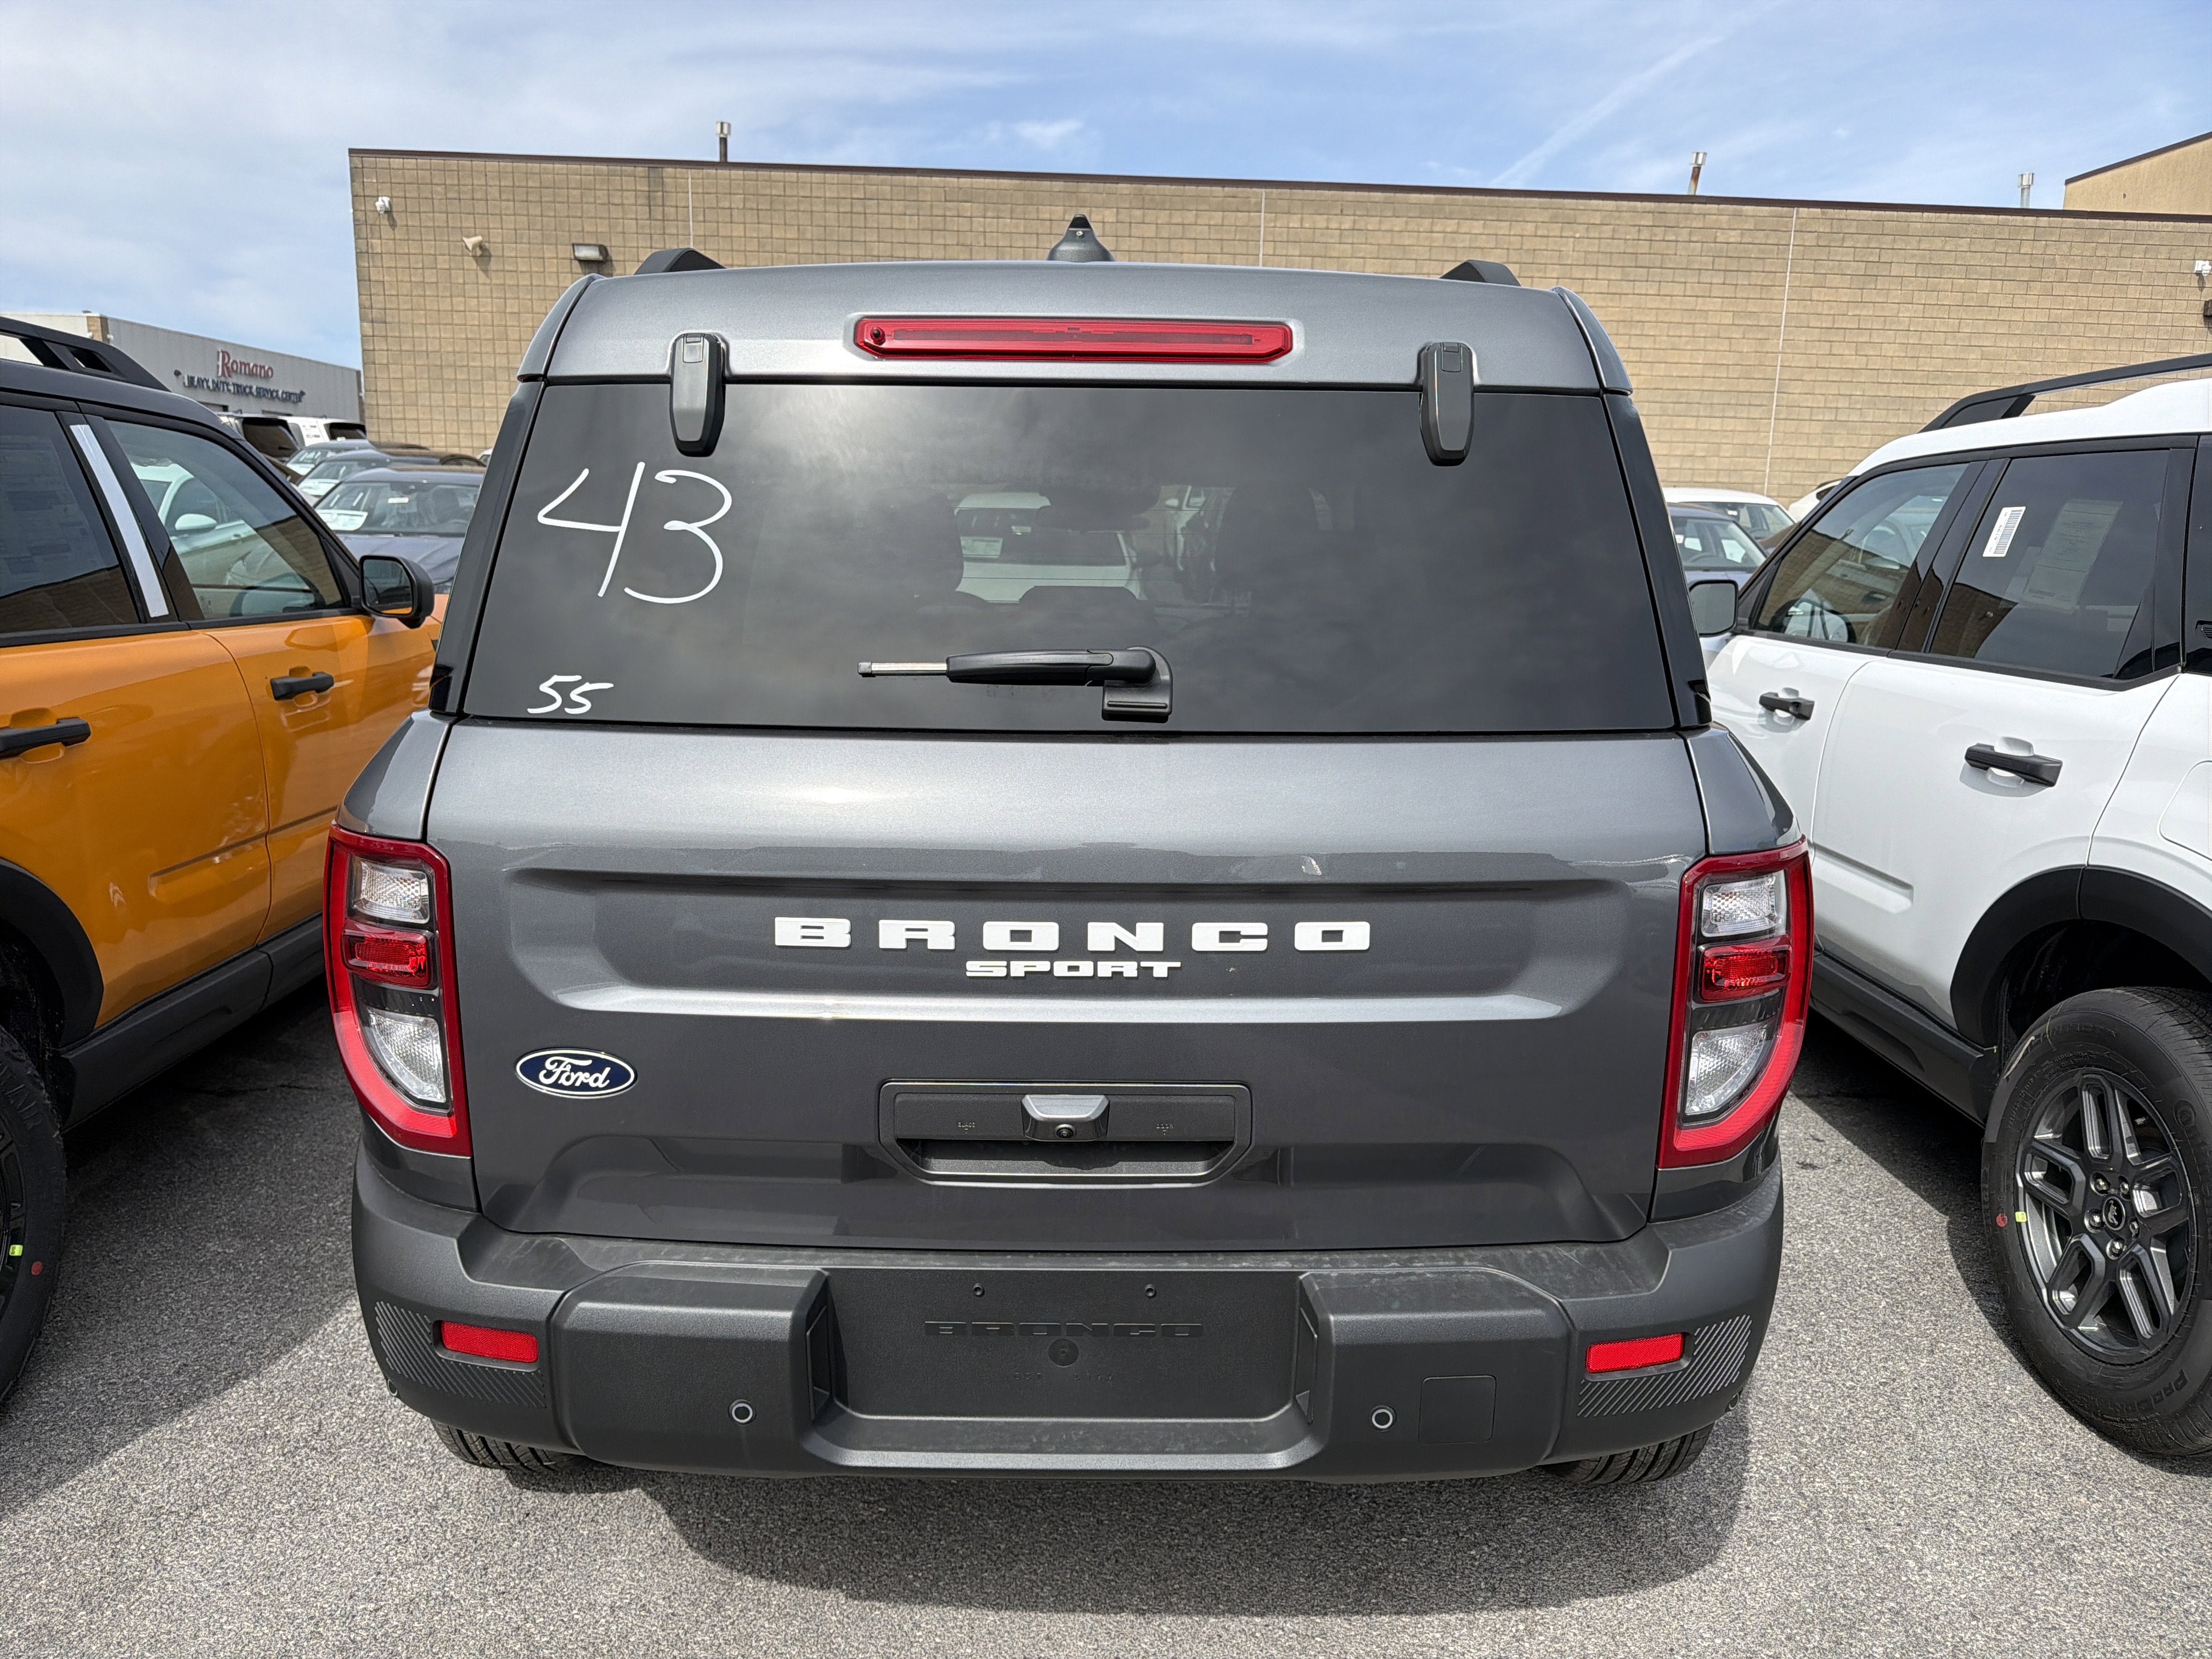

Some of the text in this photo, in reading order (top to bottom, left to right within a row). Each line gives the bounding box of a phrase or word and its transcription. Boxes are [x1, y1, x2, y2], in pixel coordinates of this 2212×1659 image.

[220, 349, 274, 379] Romano
[232, 382, 253, 396] TRUCK
[537, 461, 732, 604] 43
[527, 675, 614, 714] 55
[775, 917, 1370, 951] BRONCO
[966, 961, 1181, 978] SPORT
[539, 1056, 611, 1088] Ford
[924, 1321, 1204, 1338] BRONCO
